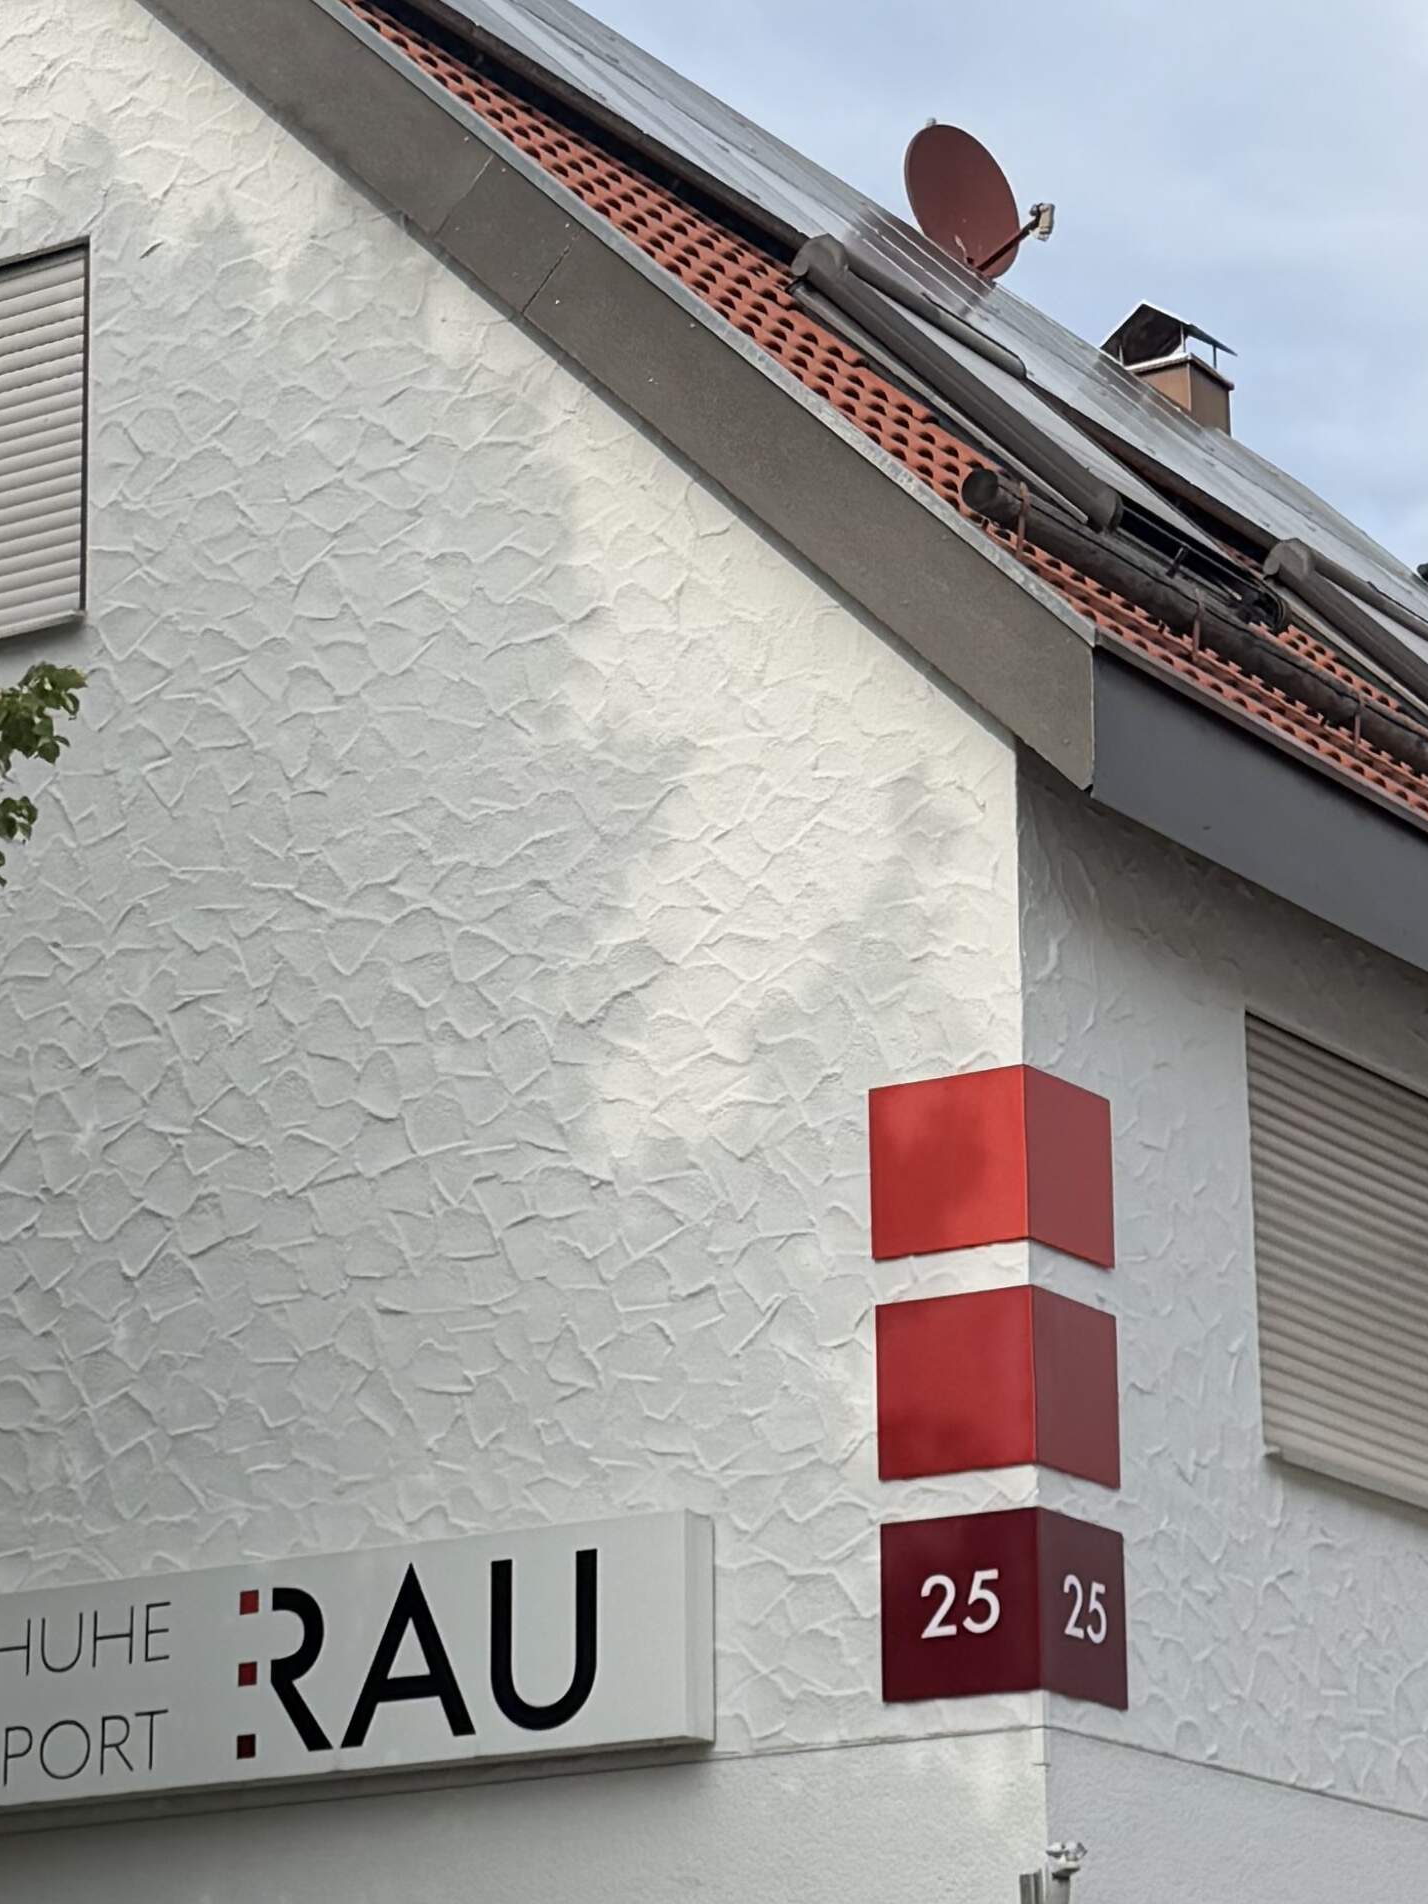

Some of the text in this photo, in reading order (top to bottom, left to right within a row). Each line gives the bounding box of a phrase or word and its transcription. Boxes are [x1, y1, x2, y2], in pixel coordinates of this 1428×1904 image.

[921, 1568, 1001, 1640] 25
[1063, 1574, 1108, 1644] 25
[237, 1548, 598, 1760] RAU
